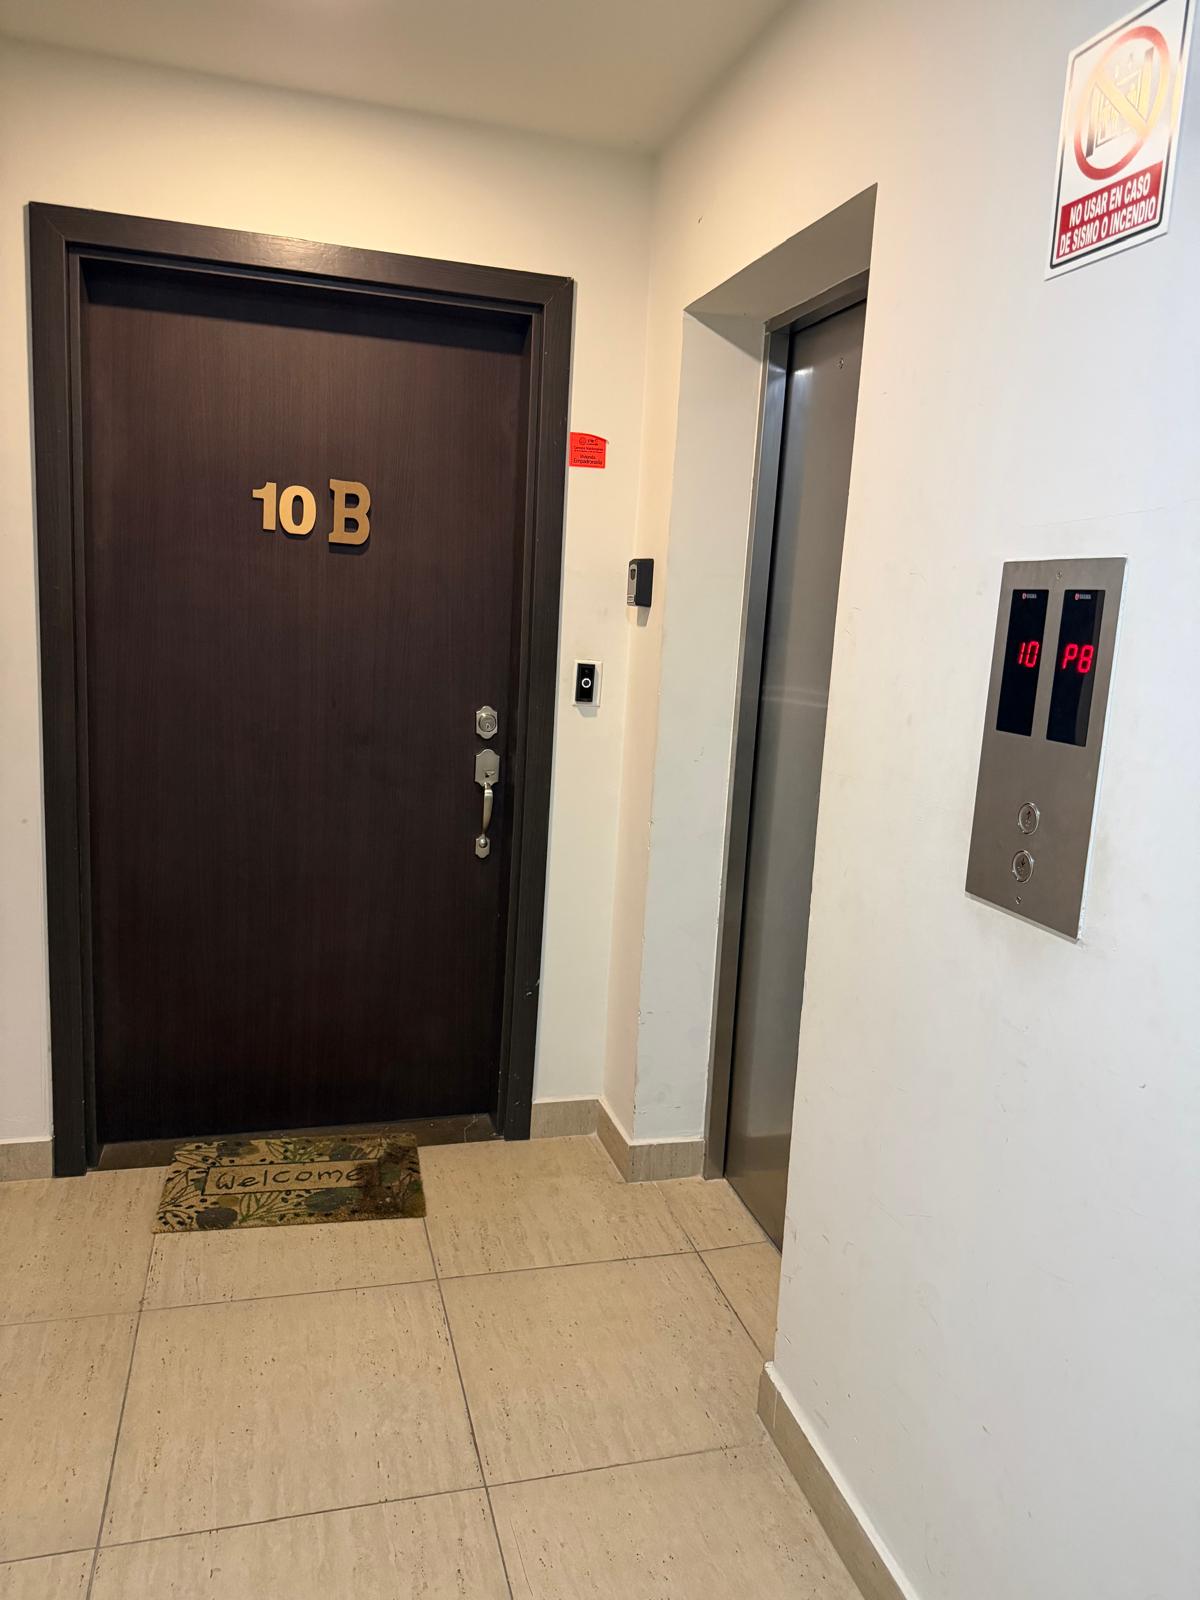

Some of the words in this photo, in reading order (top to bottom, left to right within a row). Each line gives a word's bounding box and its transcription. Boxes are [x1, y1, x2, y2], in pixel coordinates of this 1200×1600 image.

[1059, 231, 1072, 256] DE
[1072, 220, 1100, 251] SISMO
[1101, 216, 1109, 239] O
[1110, 196, 1156, 234] INCENDIO
[1069, 204, 1083, 229] NO
[1084, 192, 1108, 221] USAR
[1109, 185, 1124, 212] EN
[1124, 172, 1151, 204] CASO
[252, 481, 317, 536] 10
[328, 478, 371, 546] B
[1018, 641, 1040, 668] 10
